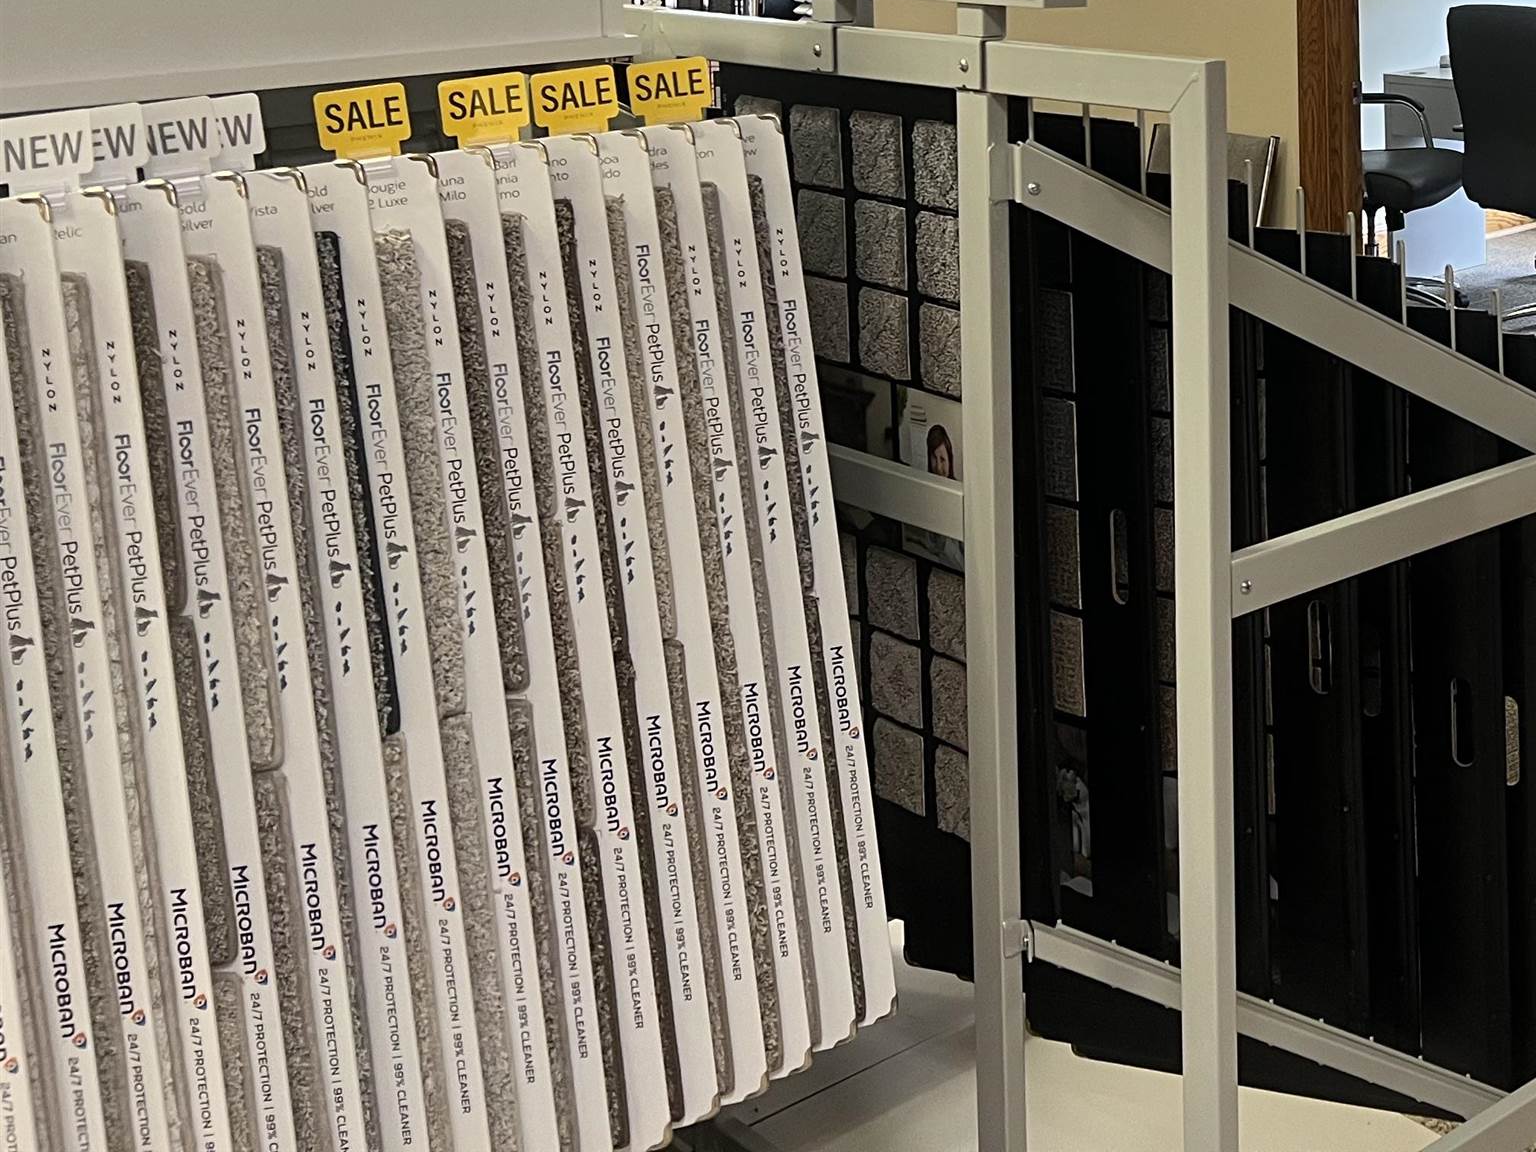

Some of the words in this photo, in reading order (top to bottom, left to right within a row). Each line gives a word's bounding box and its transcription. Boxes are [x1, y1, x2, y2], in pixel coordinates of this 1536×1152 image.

[448, 84, 523, 120] SALE
[541, 77, 613, 113] SALE
[635, 68, 705, 102] SALE
[92, 123, 136, 161] EW
[325, 96, 403, 134] SALE
[4, 130, 82, 173] NEW
[378, 196, 408, 209] Luxe
[688, 245, 701, 295] NYLON
[734, 238, 747, 288] NYLON
[776, 228, 788, 277] NYLON
[486, 283, 500, 336] NYLON
[539, 272, 553, 325] NYLON
[589, 260, 602, 312] NYLON
[301, 312, 315, 370] NYLON
[358, 299, 372, 356] NYLON
[429, 290, 442, 346] NYLON
[107, 341, 121, 403] NYLON
[169, 330, 184, 390] NYLON
[237, 320, 251, 379] NYLON
[646, 324, 663, 382] PetPlus
[42, 349, 57, 412] NYLON
[793, 373, 811, 428] PetPlus
[705, 397, 723, 455] PetPlus
[750, 387, 768, 443] PetPlus
[557, 433, 576, 494] PetPlus
[607, 418, 624, 478] PetPlus
[377, 473, 396, 539] PetPlus
[446, 459, 466, 523] PetPlus
[503, 448, 521, 511] PetPlus
[188, 515, 208, 586] PetPlus
[257, 501, 277, 570] PetPlus
[321, 490, 340, 557] PetPlus
[0, 557, 21, 631] PetPlus
[62, 541, 83, 614] PetPlus
[126, 531, 146, 603] PetPlus
[807, 792, 821, 855] PROTECTION
[850, 769, 863, 831] PROTECTION
[717, 834, 730, 899] PROTECTION
[764, 813, 778, 877] PROTECTION
[857, 841, 867, 862] 99%
[667, 851, 681, 918] PROTECTION
[772, 887, 783, 907] 99%
[816, 865, 825, 885] 99%
[860, 864, 873, 909] CLEANER
[562, 902, 577, 970] PROTECTION
[617, 875, 633, 943] PROTECTION
[725, 909, 734, 930] 99%
[775, 911, 788, 958] CLEANER
[819, 887, 831, 933] CLEANER
[509, 923, 524, 994] PROTECTION
[627, 954, 637, 976] 99%
[675, 928, 686, 949] 99%
[728, 933, 742, 981] CLEANER
[444, 948, 459, 1022] PROTECTION
[571, 982, 581, 1005] 99%
[630, 979, 644, 1029] CLEANER
[679, 952, 692, 1001] CLEANER
[385, 977, 400, 1052] PROTECTION
[518, 1005, 528, 1029] 99%
[574, 1007, 588, 1059] CLEANER
[323, 999, 339, 1075] PROTECTION
[333, 1088, 344, 1113] 99%
[454, 1033, 464, 1057] 99%
[521, 1032, 535, 1084] CLEANER
[194, 1050, 212, 1129] PROTECTION
[254, 1024, 272, 1102] PROTECTION
[266, 1114, 278, 1140] 99%
[394, 1063, 405, 1087] 99%
[456, 1060, 471, 1114] CLEANER
[132, 1065, 150, 1146] PROTECTION
[397, 1092, 412, 1145] CLEANER
